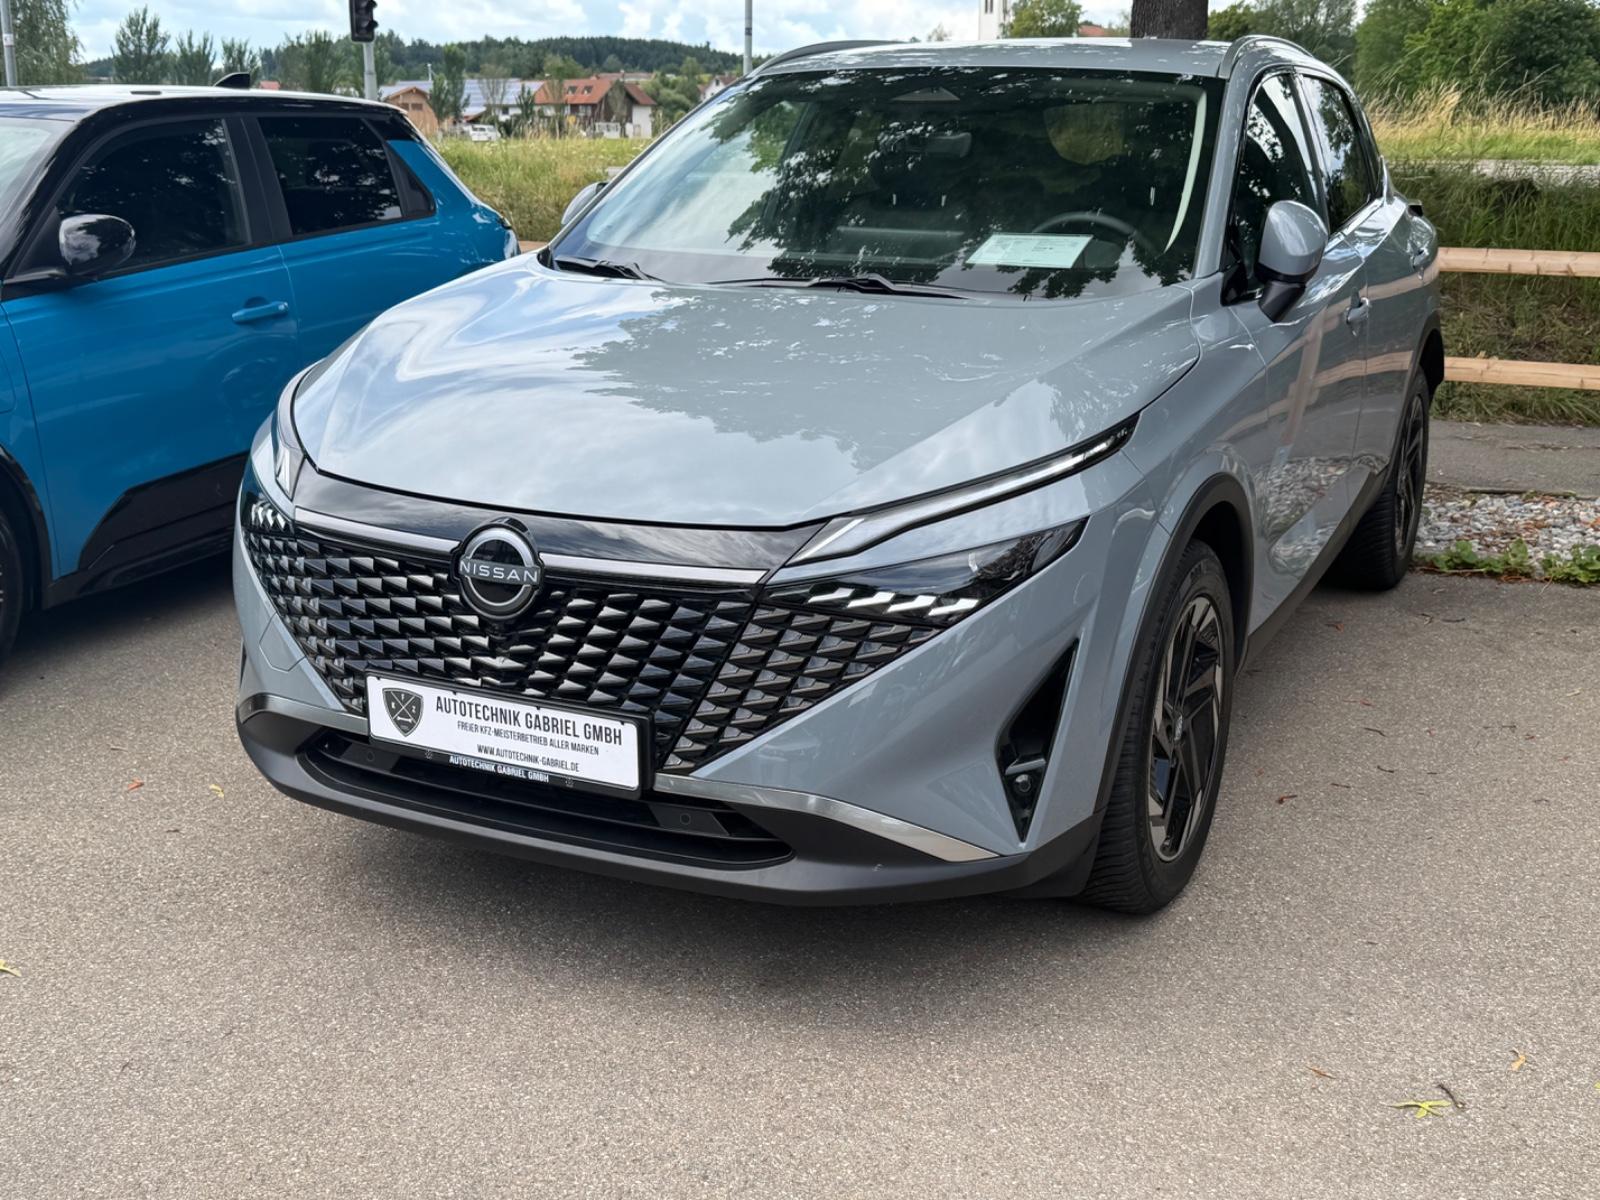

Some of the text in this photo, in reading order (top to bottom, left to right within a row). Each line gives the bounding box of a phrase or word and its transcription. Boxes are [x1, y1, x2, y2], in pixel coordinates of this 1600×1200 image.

[460, 560, 538, 582] NISSAN
[436, 696, 622, 746] AUTOTECHNIK GABRIEL GMBH
[457, 720, 599, 756] FREIER KFZ-MEISTERBETRIEB ALLER MARKEN
[449, 755, 549, 783] AUTOTECHNIK GABRIEL GMBH
[477, 744, 580, 772] WWW.AUTOTECHNIK-GABRIEL.DE
